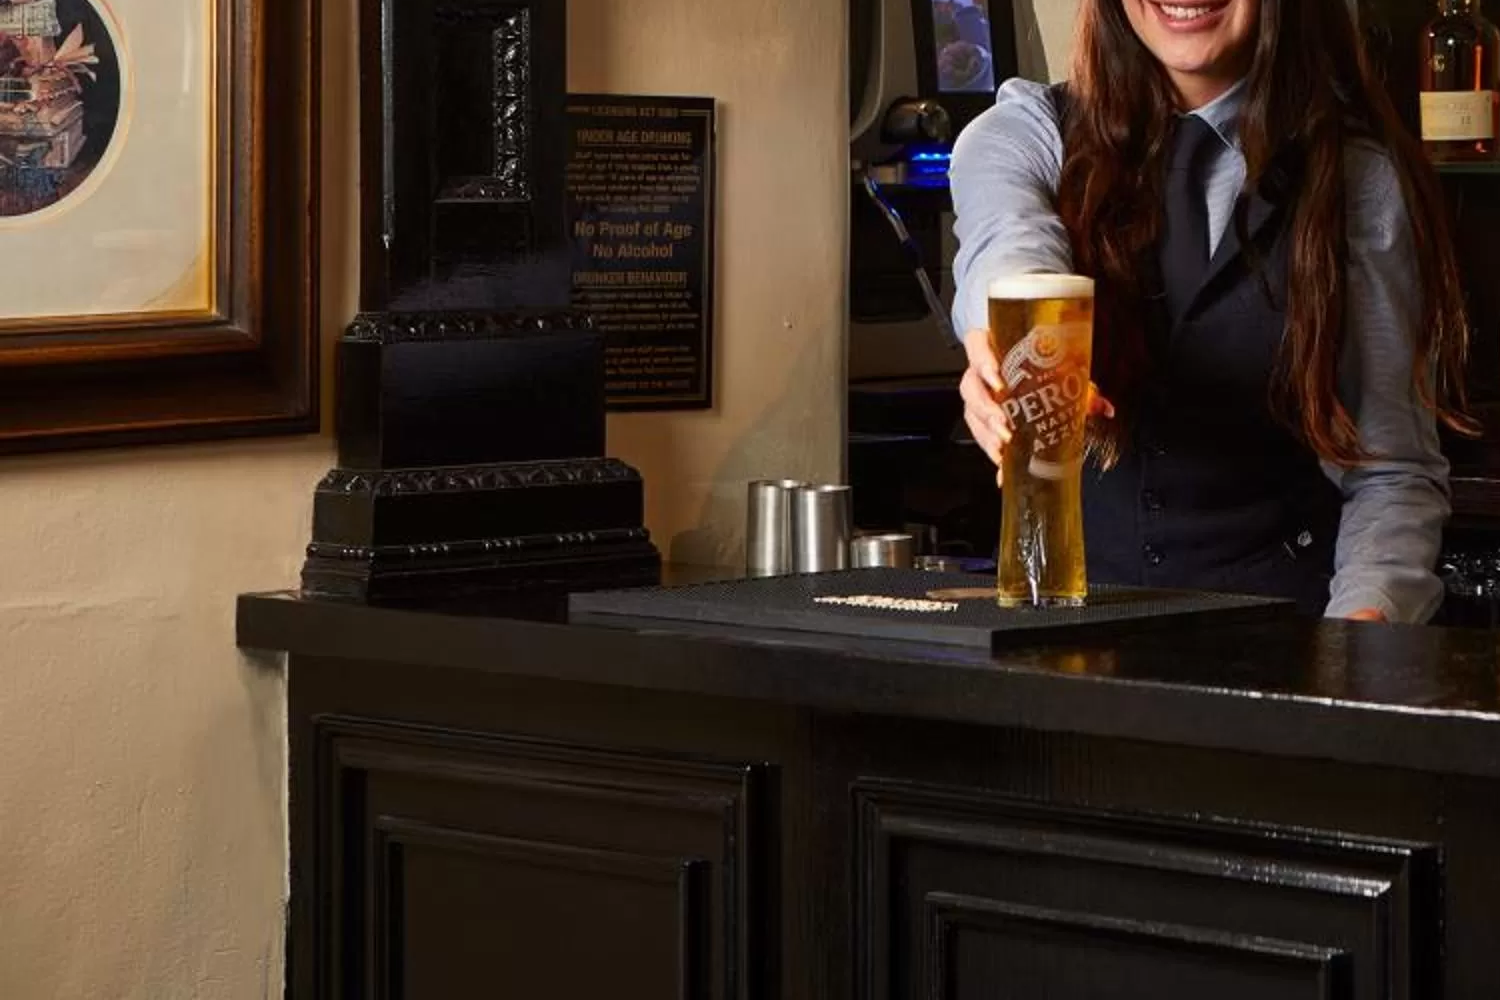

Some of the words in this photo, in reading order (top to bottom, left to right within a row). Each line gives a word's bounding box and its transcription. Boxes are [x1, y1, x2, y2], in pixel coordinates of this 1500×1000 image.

[616, 129, 640, 143] AGE
[574, 221, 595, 237] No
[599, 221, 640, 237] Proof
[643, 221, 658, 237] of
[663, 222, 694, 240] Age
[592, 243, 613, 258] No
[617, 243, 674, 258] Alcohol
